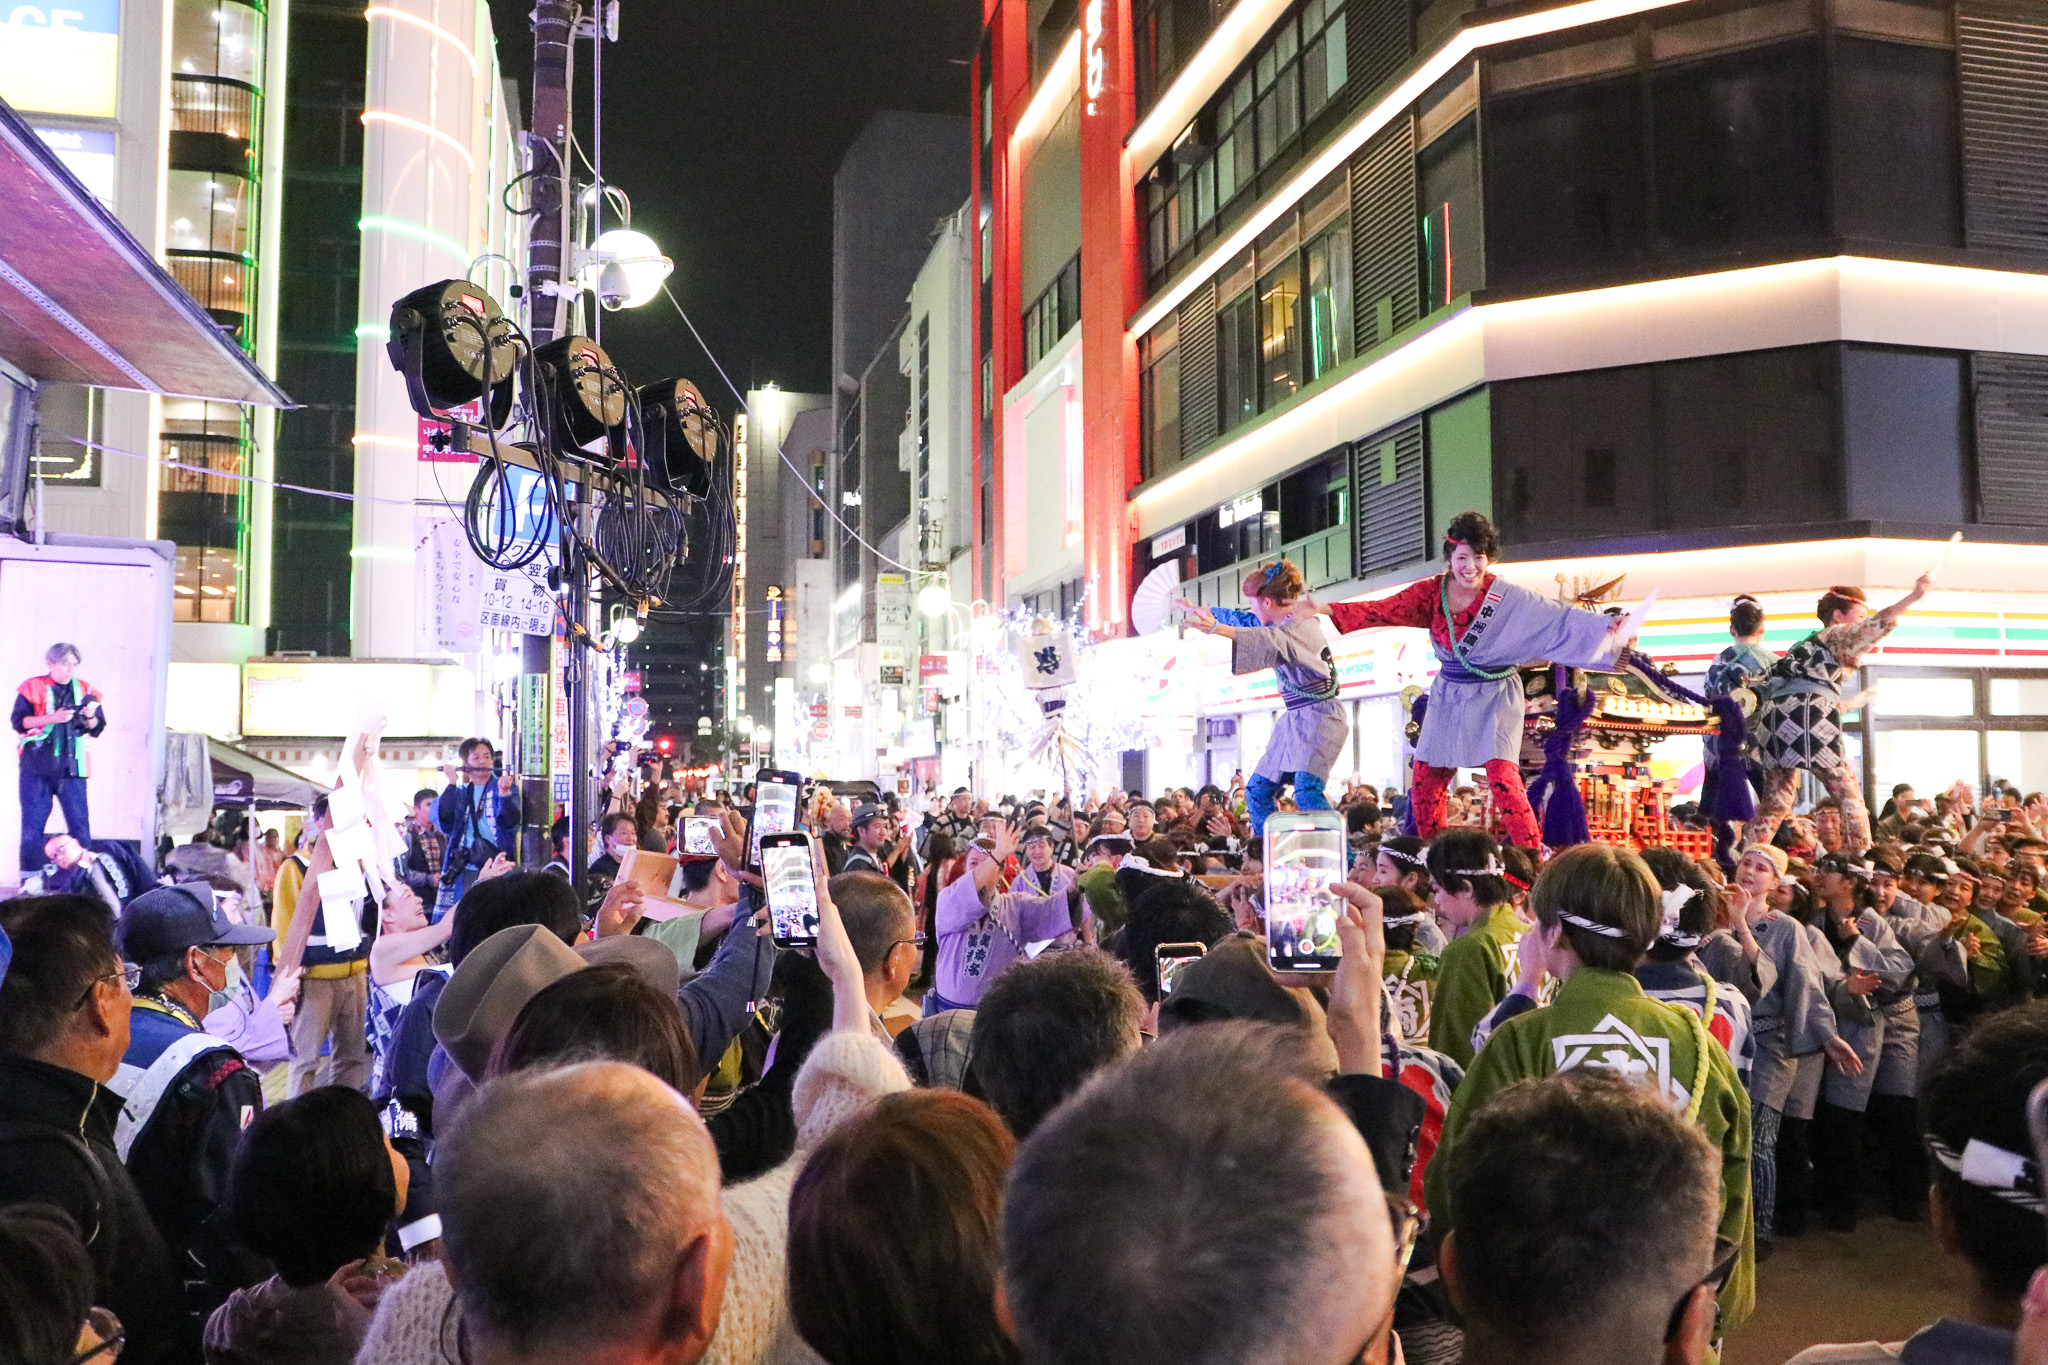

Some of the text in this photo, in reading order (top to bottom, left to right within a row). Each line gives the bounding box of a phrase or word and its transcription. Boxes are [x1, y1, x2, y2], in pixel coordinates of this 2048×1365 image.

[516, 473, 559, 533] P
[433, 550, 444, 636] まちをつくります
[450, 538, 462, 604] 安全で安心な
[480, 610, 548, 634] 区画線内に限る
[483, 592, 550, 615] 10-12 14-16
